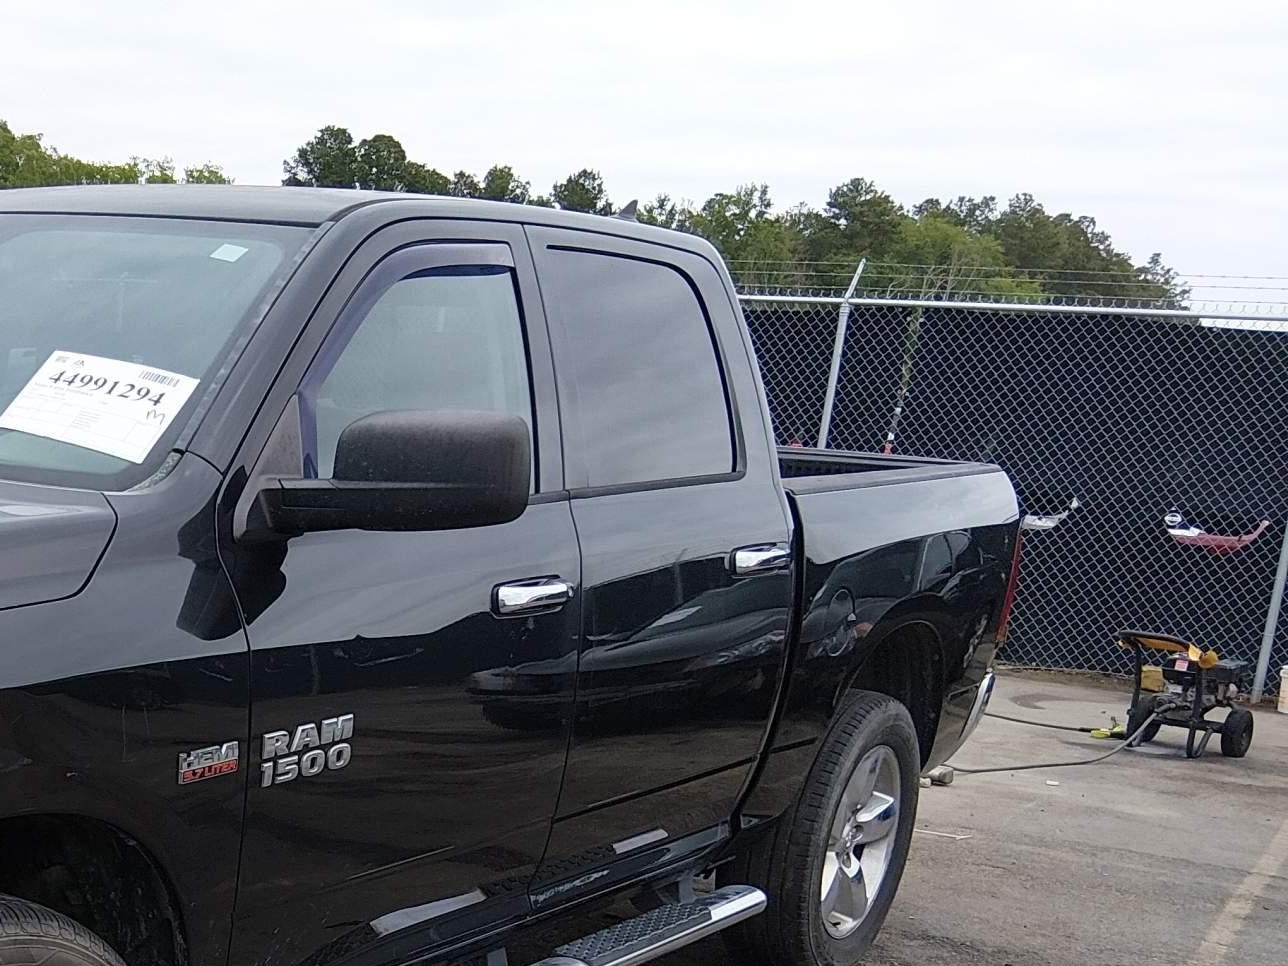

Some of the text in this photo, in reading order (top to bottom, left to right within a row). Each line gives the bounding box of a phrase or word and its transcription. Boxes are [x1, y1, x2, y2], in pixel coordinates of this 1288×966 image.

[49, 370, 165, 406] 44991294
[262, 713, 354, 758] RAM
[178, 741, 239, 771] HEMI
[204, 759, 237, 777] LITER
[261, 742, 352, 788] 1500
